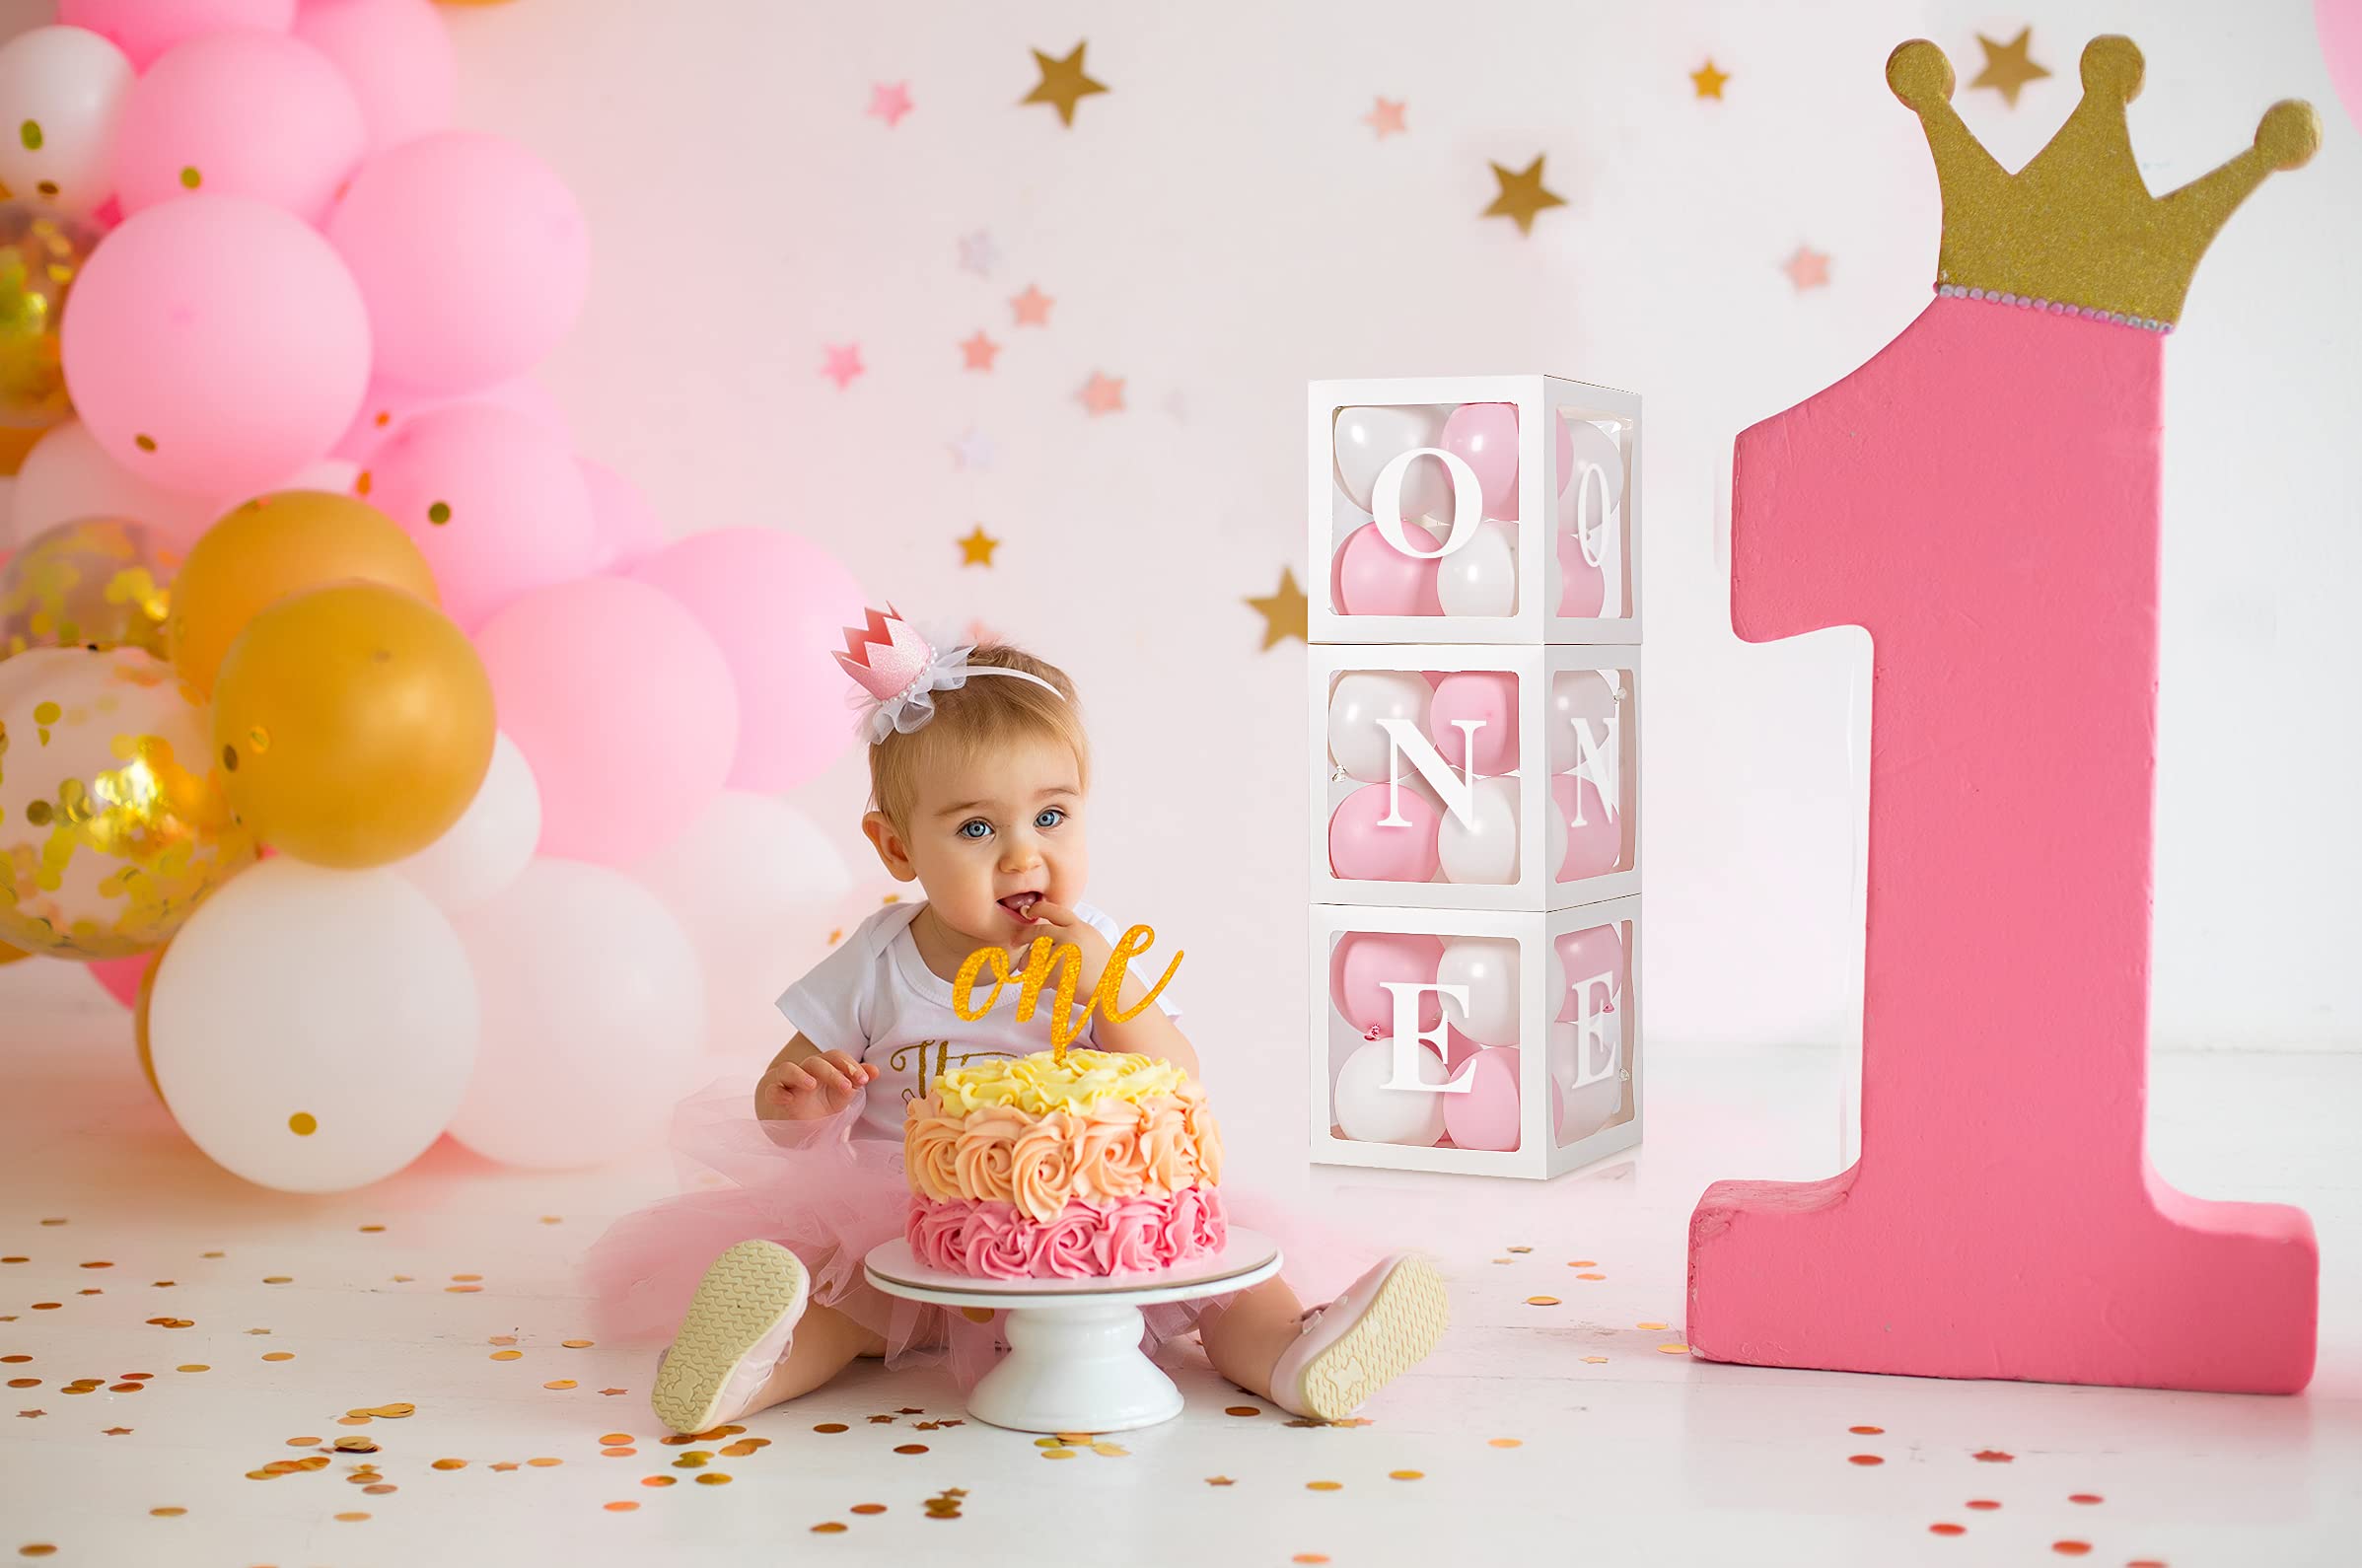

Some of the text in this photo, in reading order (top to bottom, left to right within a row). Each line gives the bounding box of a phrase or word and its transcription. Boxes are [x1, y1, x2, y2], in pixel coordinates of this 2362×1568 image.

[1372, 447, 1482, 559] O
[1376, 719, 1487, 831] N
[1571, 718, 1619, 827] N
[952, 923, 1184, 1065] one
[1379, 981, 1477, 1094] E
[1572, 970, 1619, 1089] E
